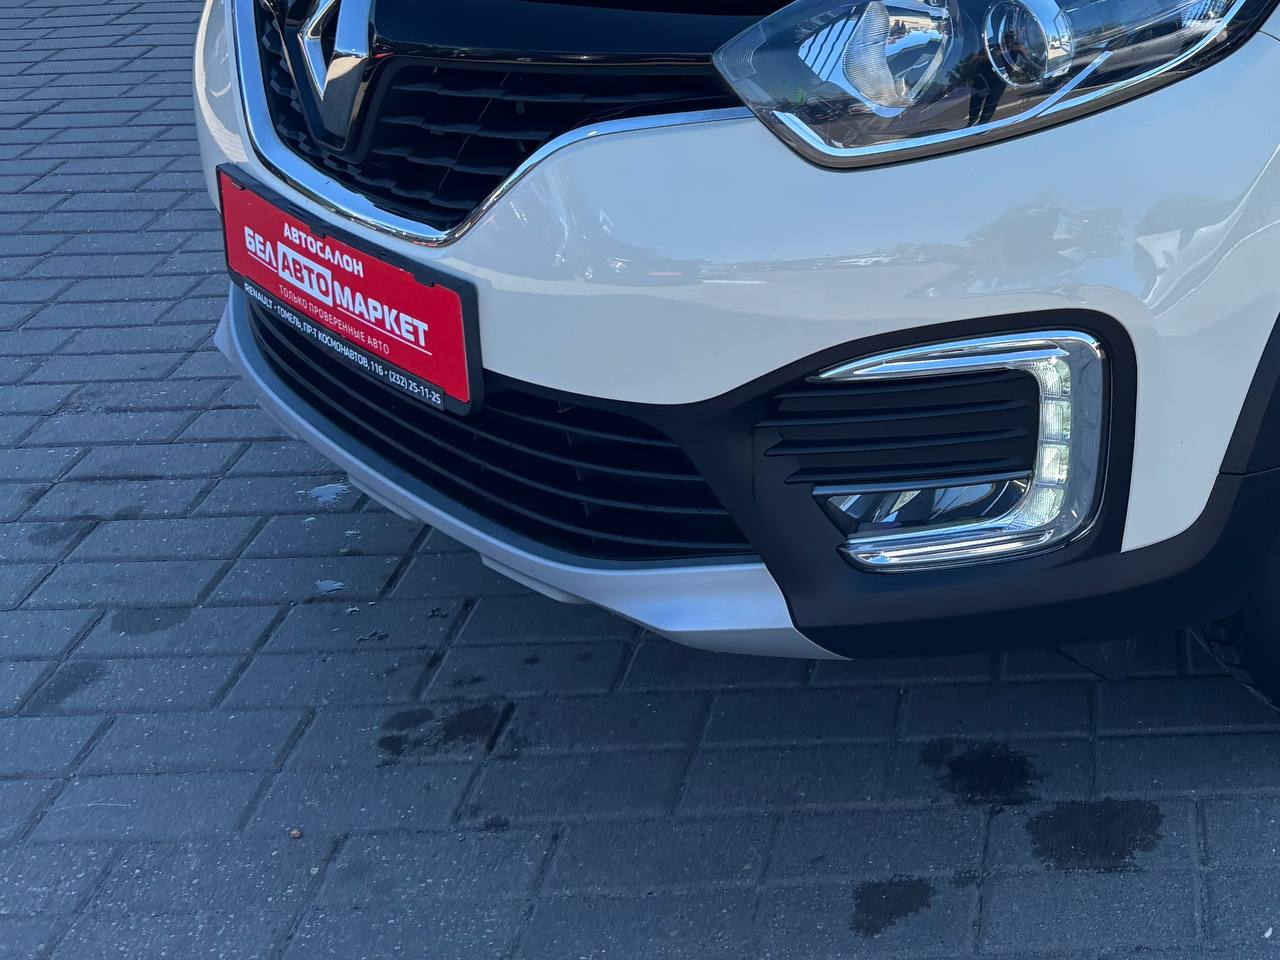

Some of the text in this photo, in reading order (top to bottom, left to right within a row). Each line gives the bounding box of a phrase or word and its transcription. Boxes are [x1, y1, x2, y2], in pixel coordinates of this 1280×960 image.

[283, 222, 364, 278] АВТОСАЛОН
[244, 282, 273, 309] RENAULT
[388, 370, 408, 390] (232)
[408, 380, 441, 404] 25-11-25
[279, 284, 390, 355] ТОЛЬКО ПРОВЕРЕННЫЕ АВТО
